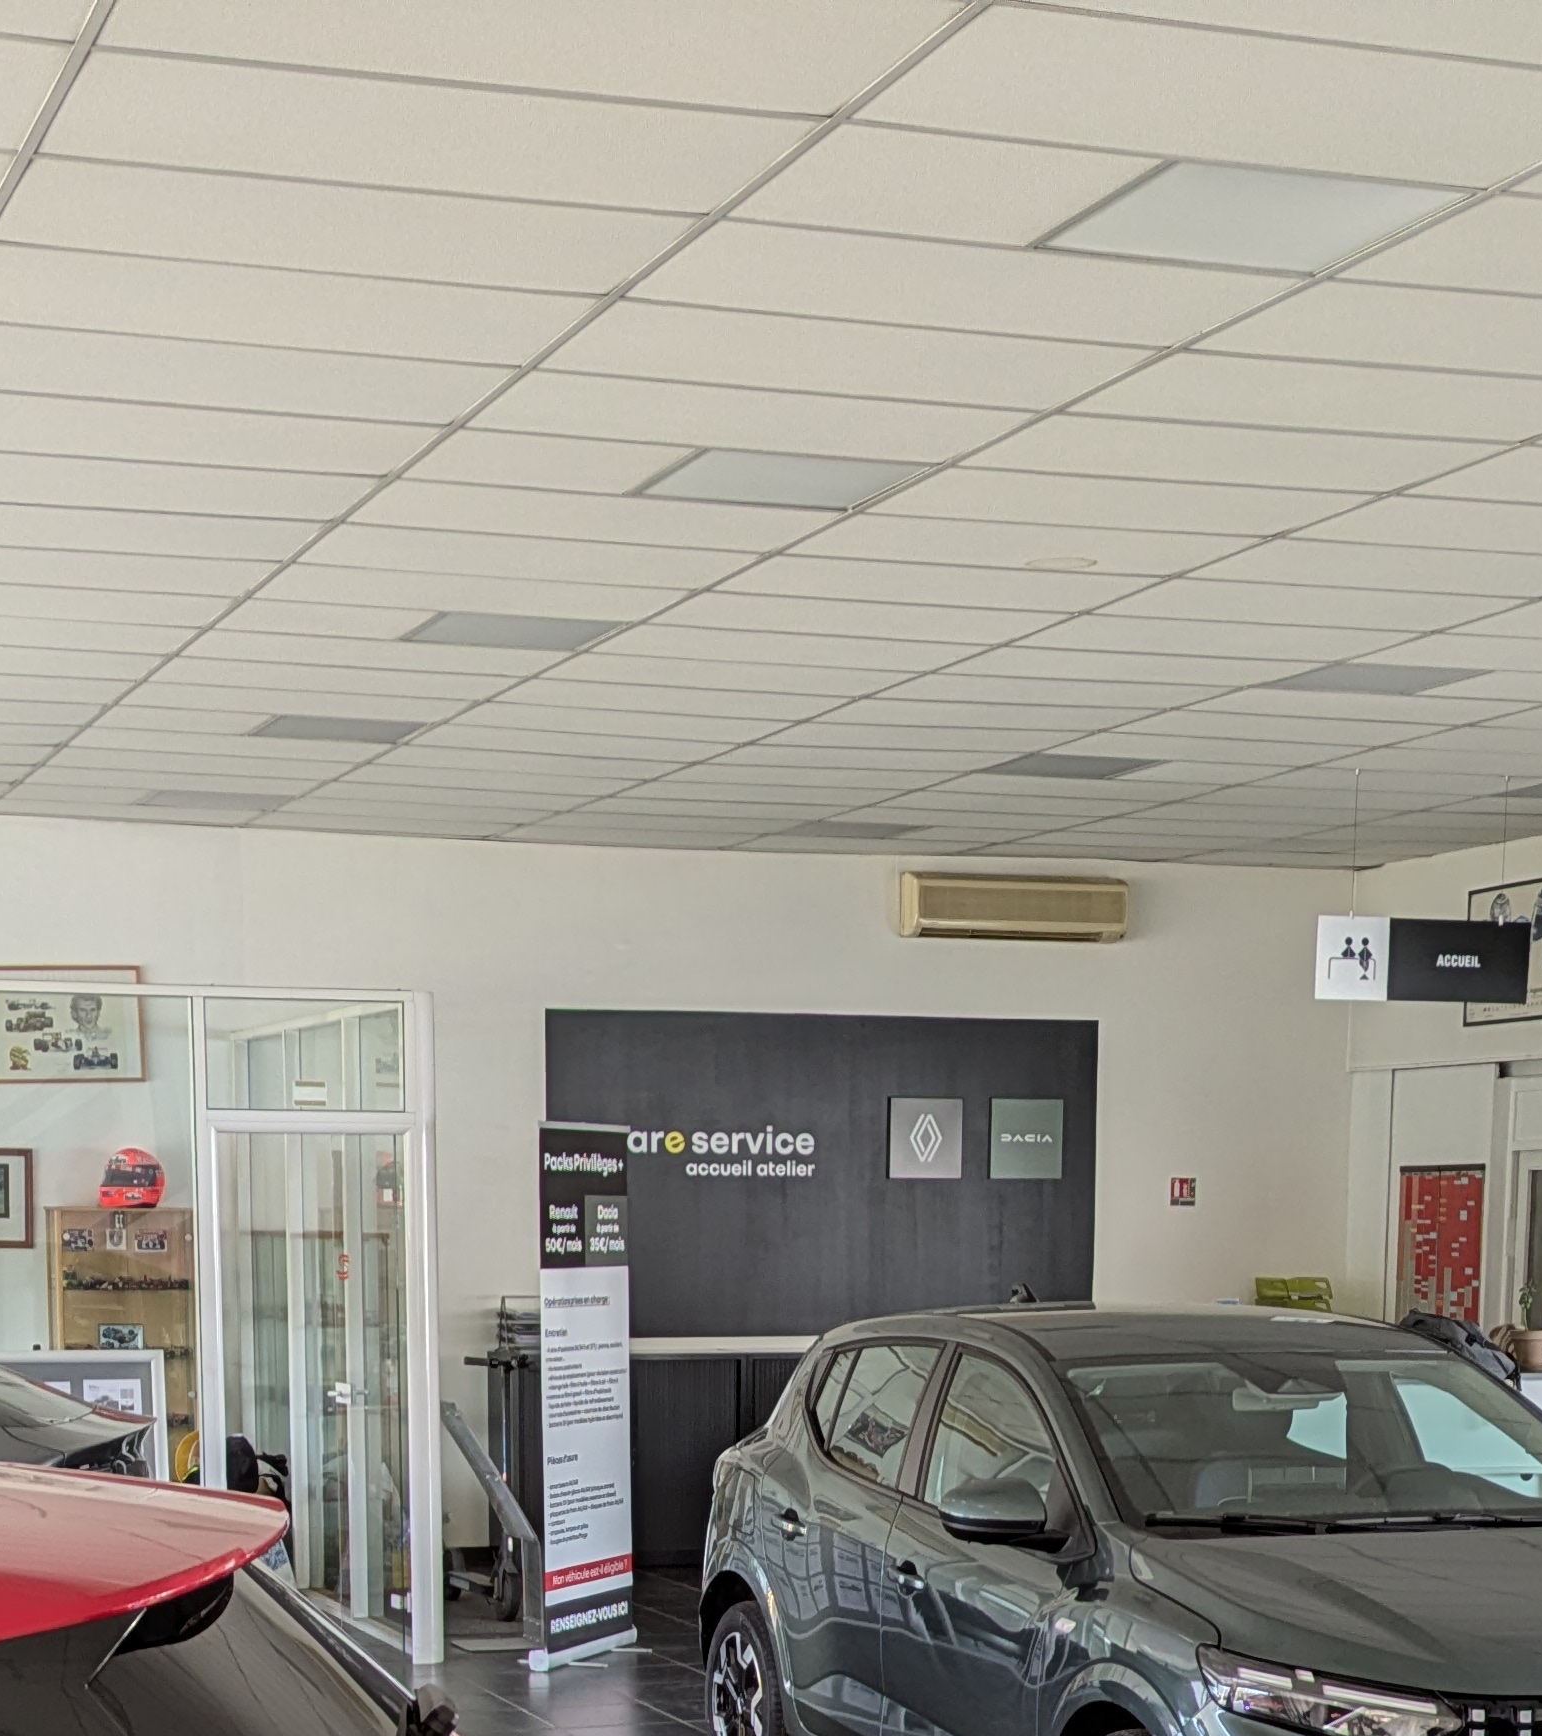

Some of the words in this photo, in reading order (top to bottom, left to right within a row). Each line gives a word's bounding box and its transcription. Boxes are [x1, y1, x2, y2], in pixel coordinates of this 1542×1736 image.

[1436, 953, 1481, 968] ACCUEIL
[691, 1125, 815, 1154] service
[1000, 1132, 1053, 1143] DACIA
[544, 1152, 573, 1171] Packs
[685, 1160, 752, 1177] accueil
[756, 1160, 816, 1178] atelier
[549, 1204, 578, 1220] Renault
[597, 1204, 619, 1219] Dacia
